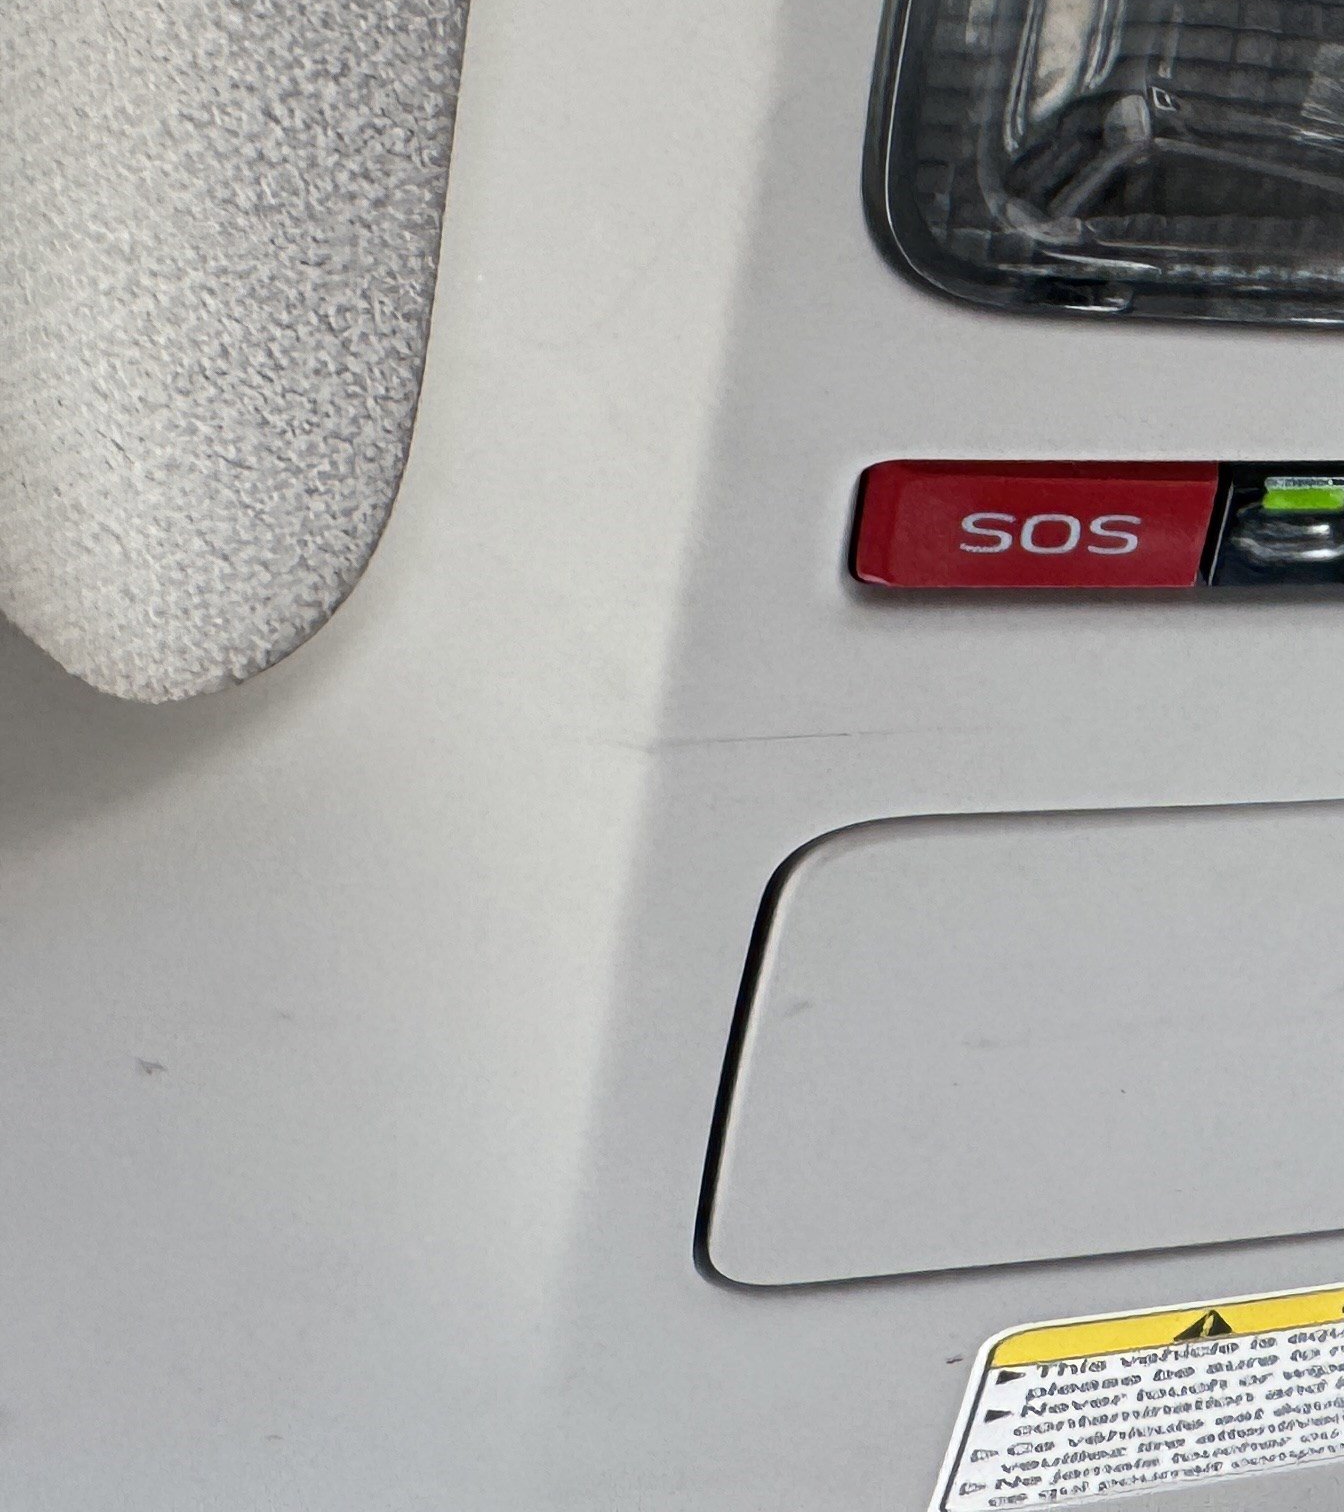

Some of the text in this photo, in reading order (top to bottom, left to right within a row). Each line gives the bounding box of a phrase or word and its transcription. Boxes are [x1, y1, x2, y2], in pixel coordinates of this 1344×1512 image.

[959, 512, 1144, 555] SOS
[1020, 1393, 1126, 1417] Never
[1135, 1378, 1227, 1402] touch
[1025, 1374, 1141, 1402] please
[1152, 1365, 1195, 1382] be
